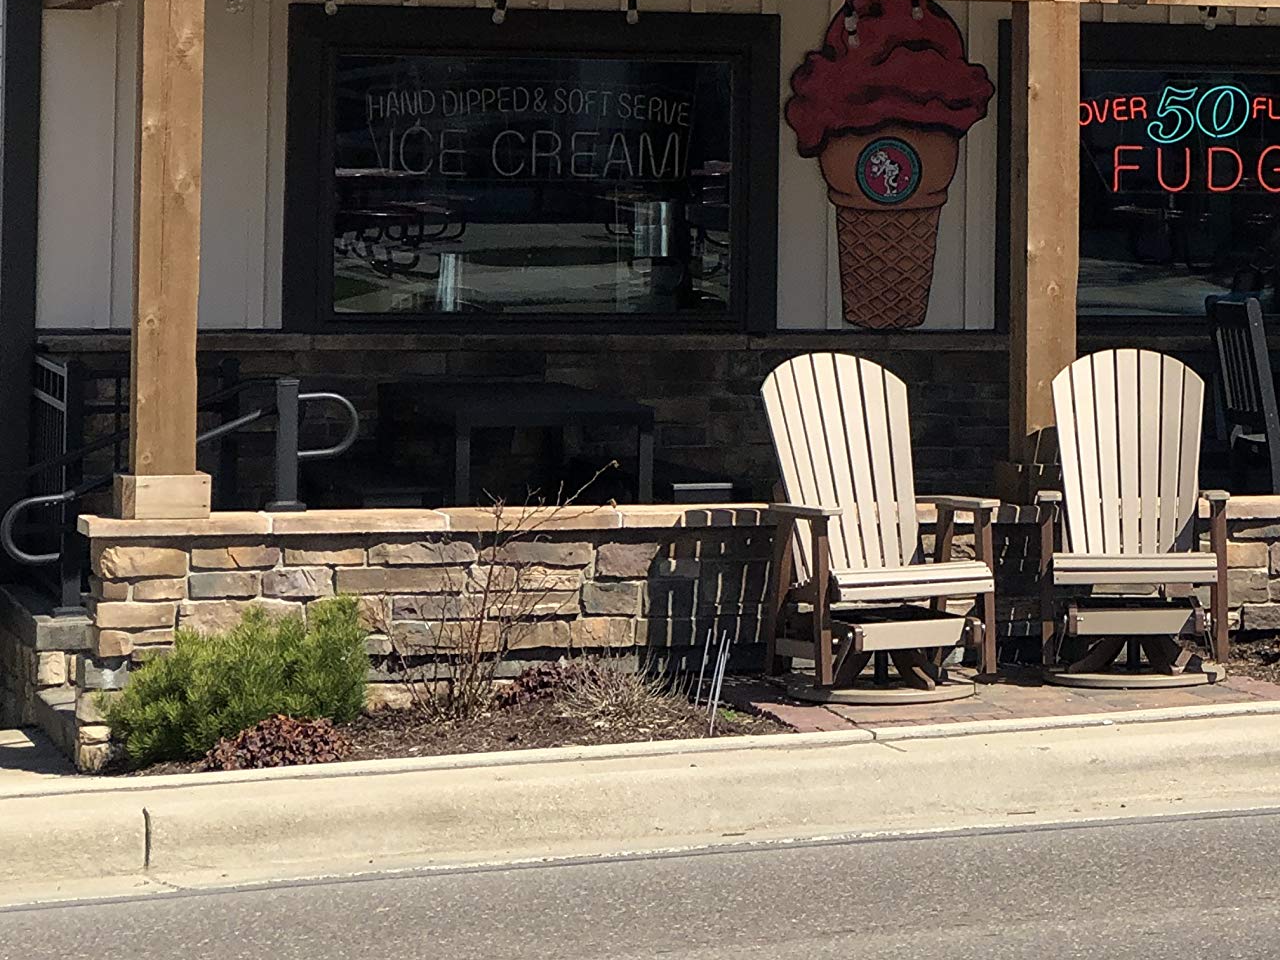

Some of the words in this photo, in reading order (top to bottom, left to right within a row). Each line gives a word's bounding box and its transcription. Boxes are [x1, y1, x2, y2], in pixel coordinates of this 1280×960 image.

[367, 88, 436, 121] HAND
[441, 86, 530, 117] DIPPED
[533, 86, 549, 115] &
[553, 88, 613, 116] SOFT
[617, 92, 691, 127] SERVE
[1079, 96, 1148, 126] OVER
[1146, 85, 1250, 144] 50
[388, 126, 469, 177] ICE
[491, 129, 681, 178] CREAM
